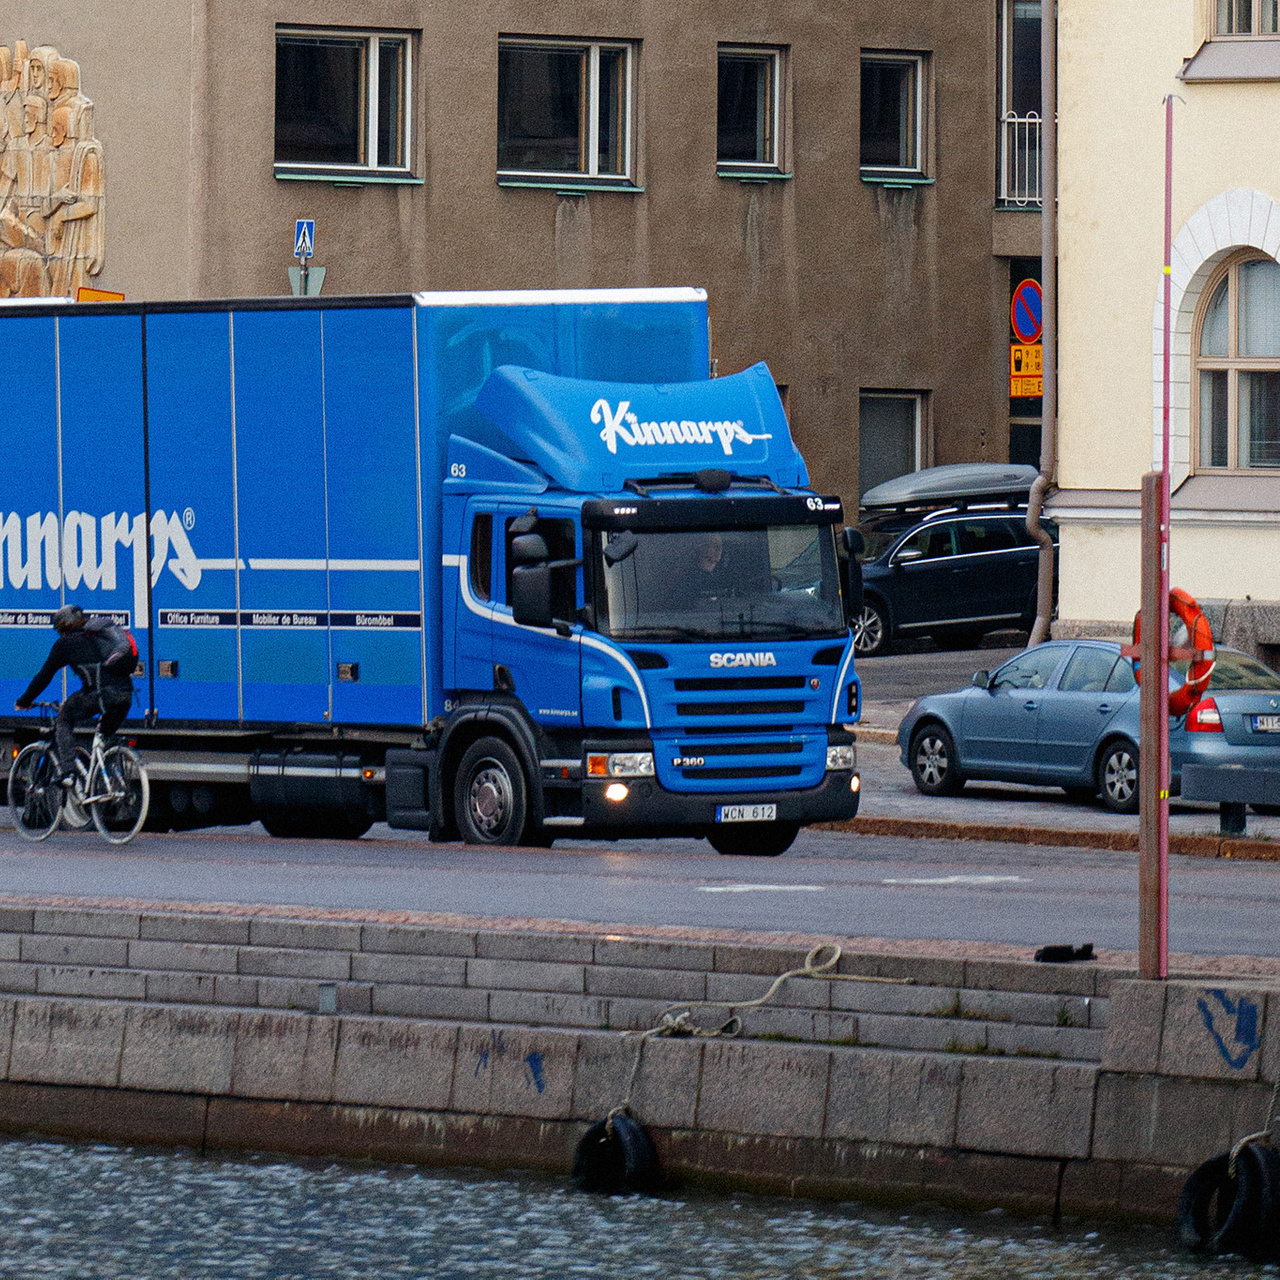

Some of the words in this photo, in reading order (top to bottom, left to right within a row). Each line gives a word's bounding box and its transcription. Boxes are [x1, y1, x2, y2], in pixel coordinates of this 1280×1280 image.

[451, 463, 466, 477] 63
[806, 497, 824, 511] 63
[16, 613, 26, 624] de
[27, 613, 51, 625] Bureau
[167, 612, 188, 625] Office
[189, 612, 220, 625] Furniture
[252, 613, 280, 626] Mobilier
[281, 613, 291, 625] de
[292, 613, 317, 626] Bureau
[355, 614, 394, 627] Büromöbel
[709, 652, 777, 668] SCANIA
[672, 757, 682, 767] P
[682, 756, 705, 767] 360
[722, 806, 745, 820] WCN
[751, 805, 775, 819] 612
